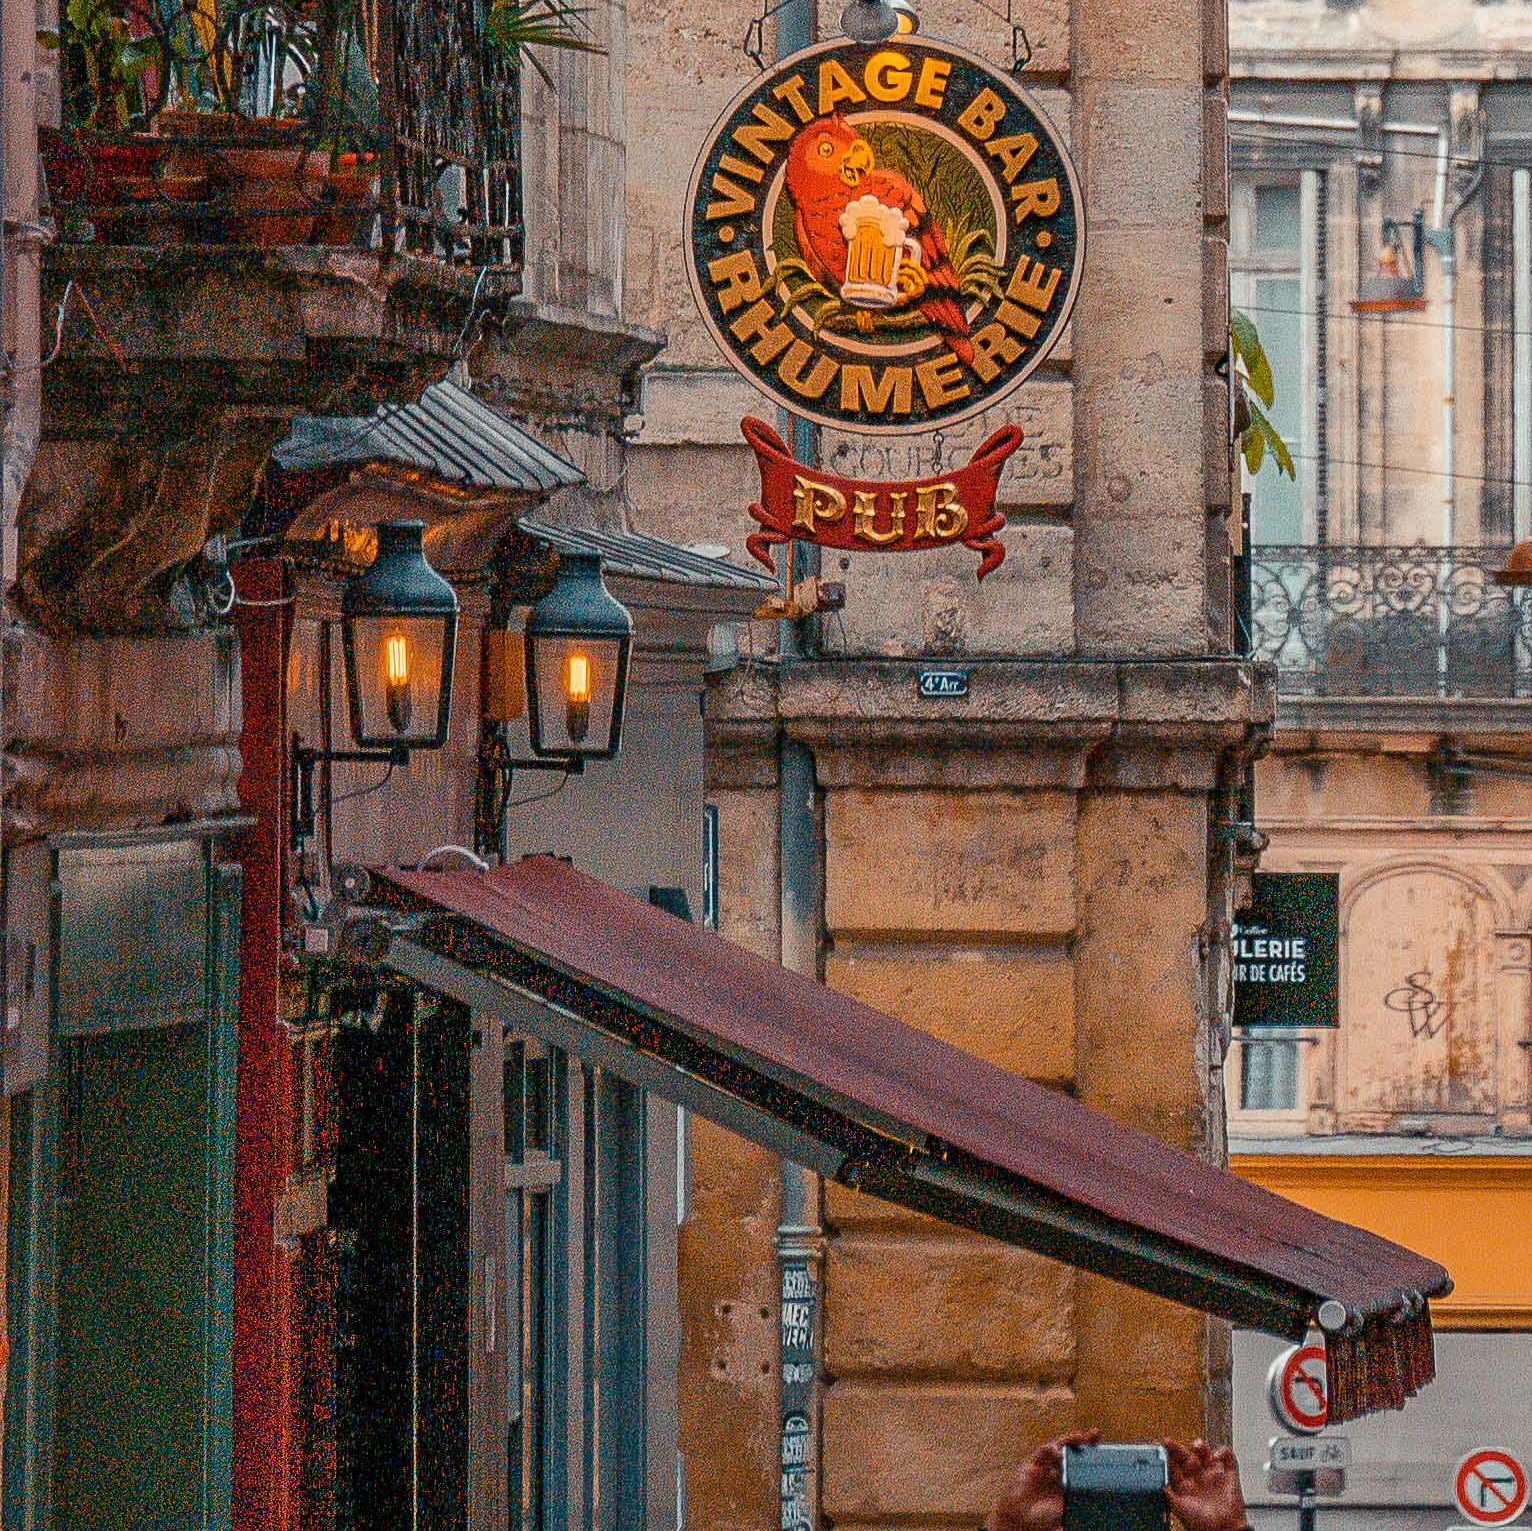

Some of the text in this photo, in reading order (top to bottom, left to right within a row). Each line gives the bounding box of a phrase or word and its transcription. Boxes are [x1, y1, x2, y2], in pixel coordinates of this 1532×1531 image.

[707, 51, 1061, 225] VINTAGE BAR
[708, 250, 1062, 414] RHUMERIE
[792, 475, 969, 545] PUB
[1249, 964, 1266, 982] DE
[1268, 961, 1306, 983] CAFÉS
